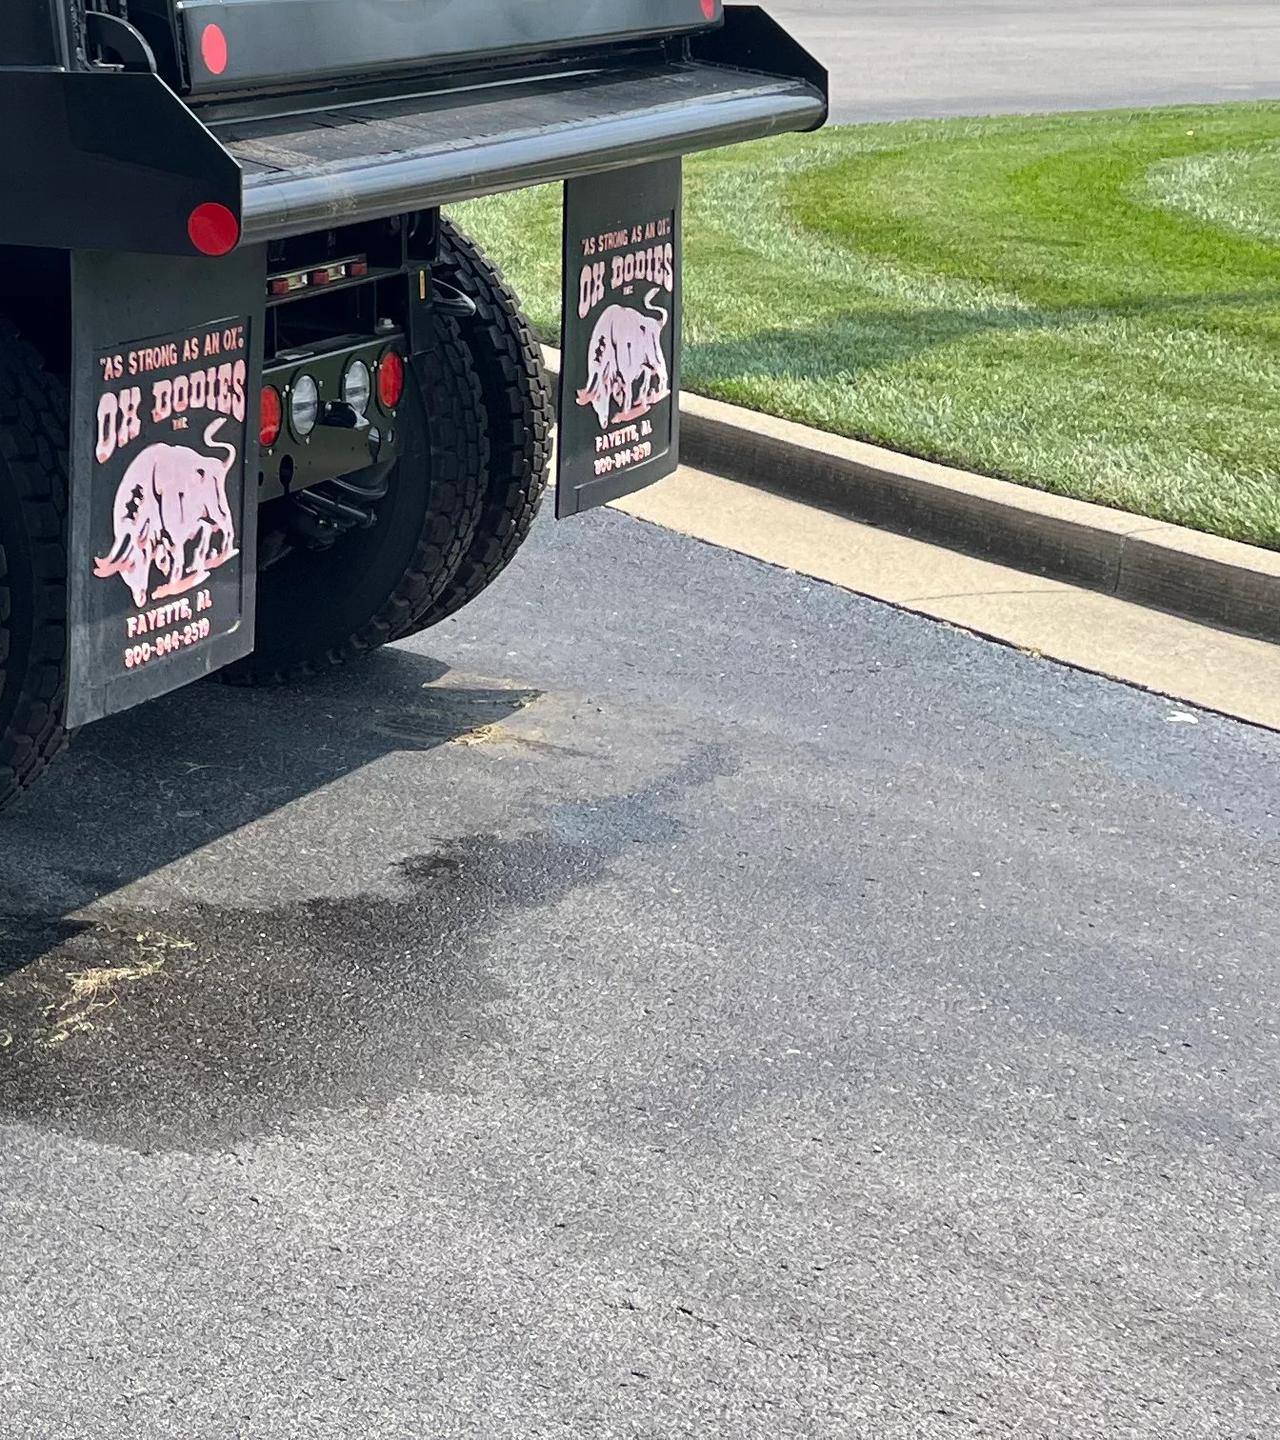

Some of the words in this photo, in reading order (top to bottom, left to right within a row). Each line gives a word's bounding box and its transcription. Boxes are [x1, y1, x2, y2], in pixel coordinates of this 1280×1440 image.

[597, 228, 629, 252] STRONG
[631, 224, 643, 244] AS
[644, 221, 656, 240] AN
[578, 261, 606, 319] OX
[611, 242, 674, 293] BODIES
[128, 342, 178, 376] STRONG
[182, 337, 200, 362] AS
[203, 331, 221, 357] AN
[95, 386, 142, 464] OX
[151, 359, 247, 424] BODIES
[126, 597, 193, 638] FAYETTE,
[196, 588, 213, 612] AL
